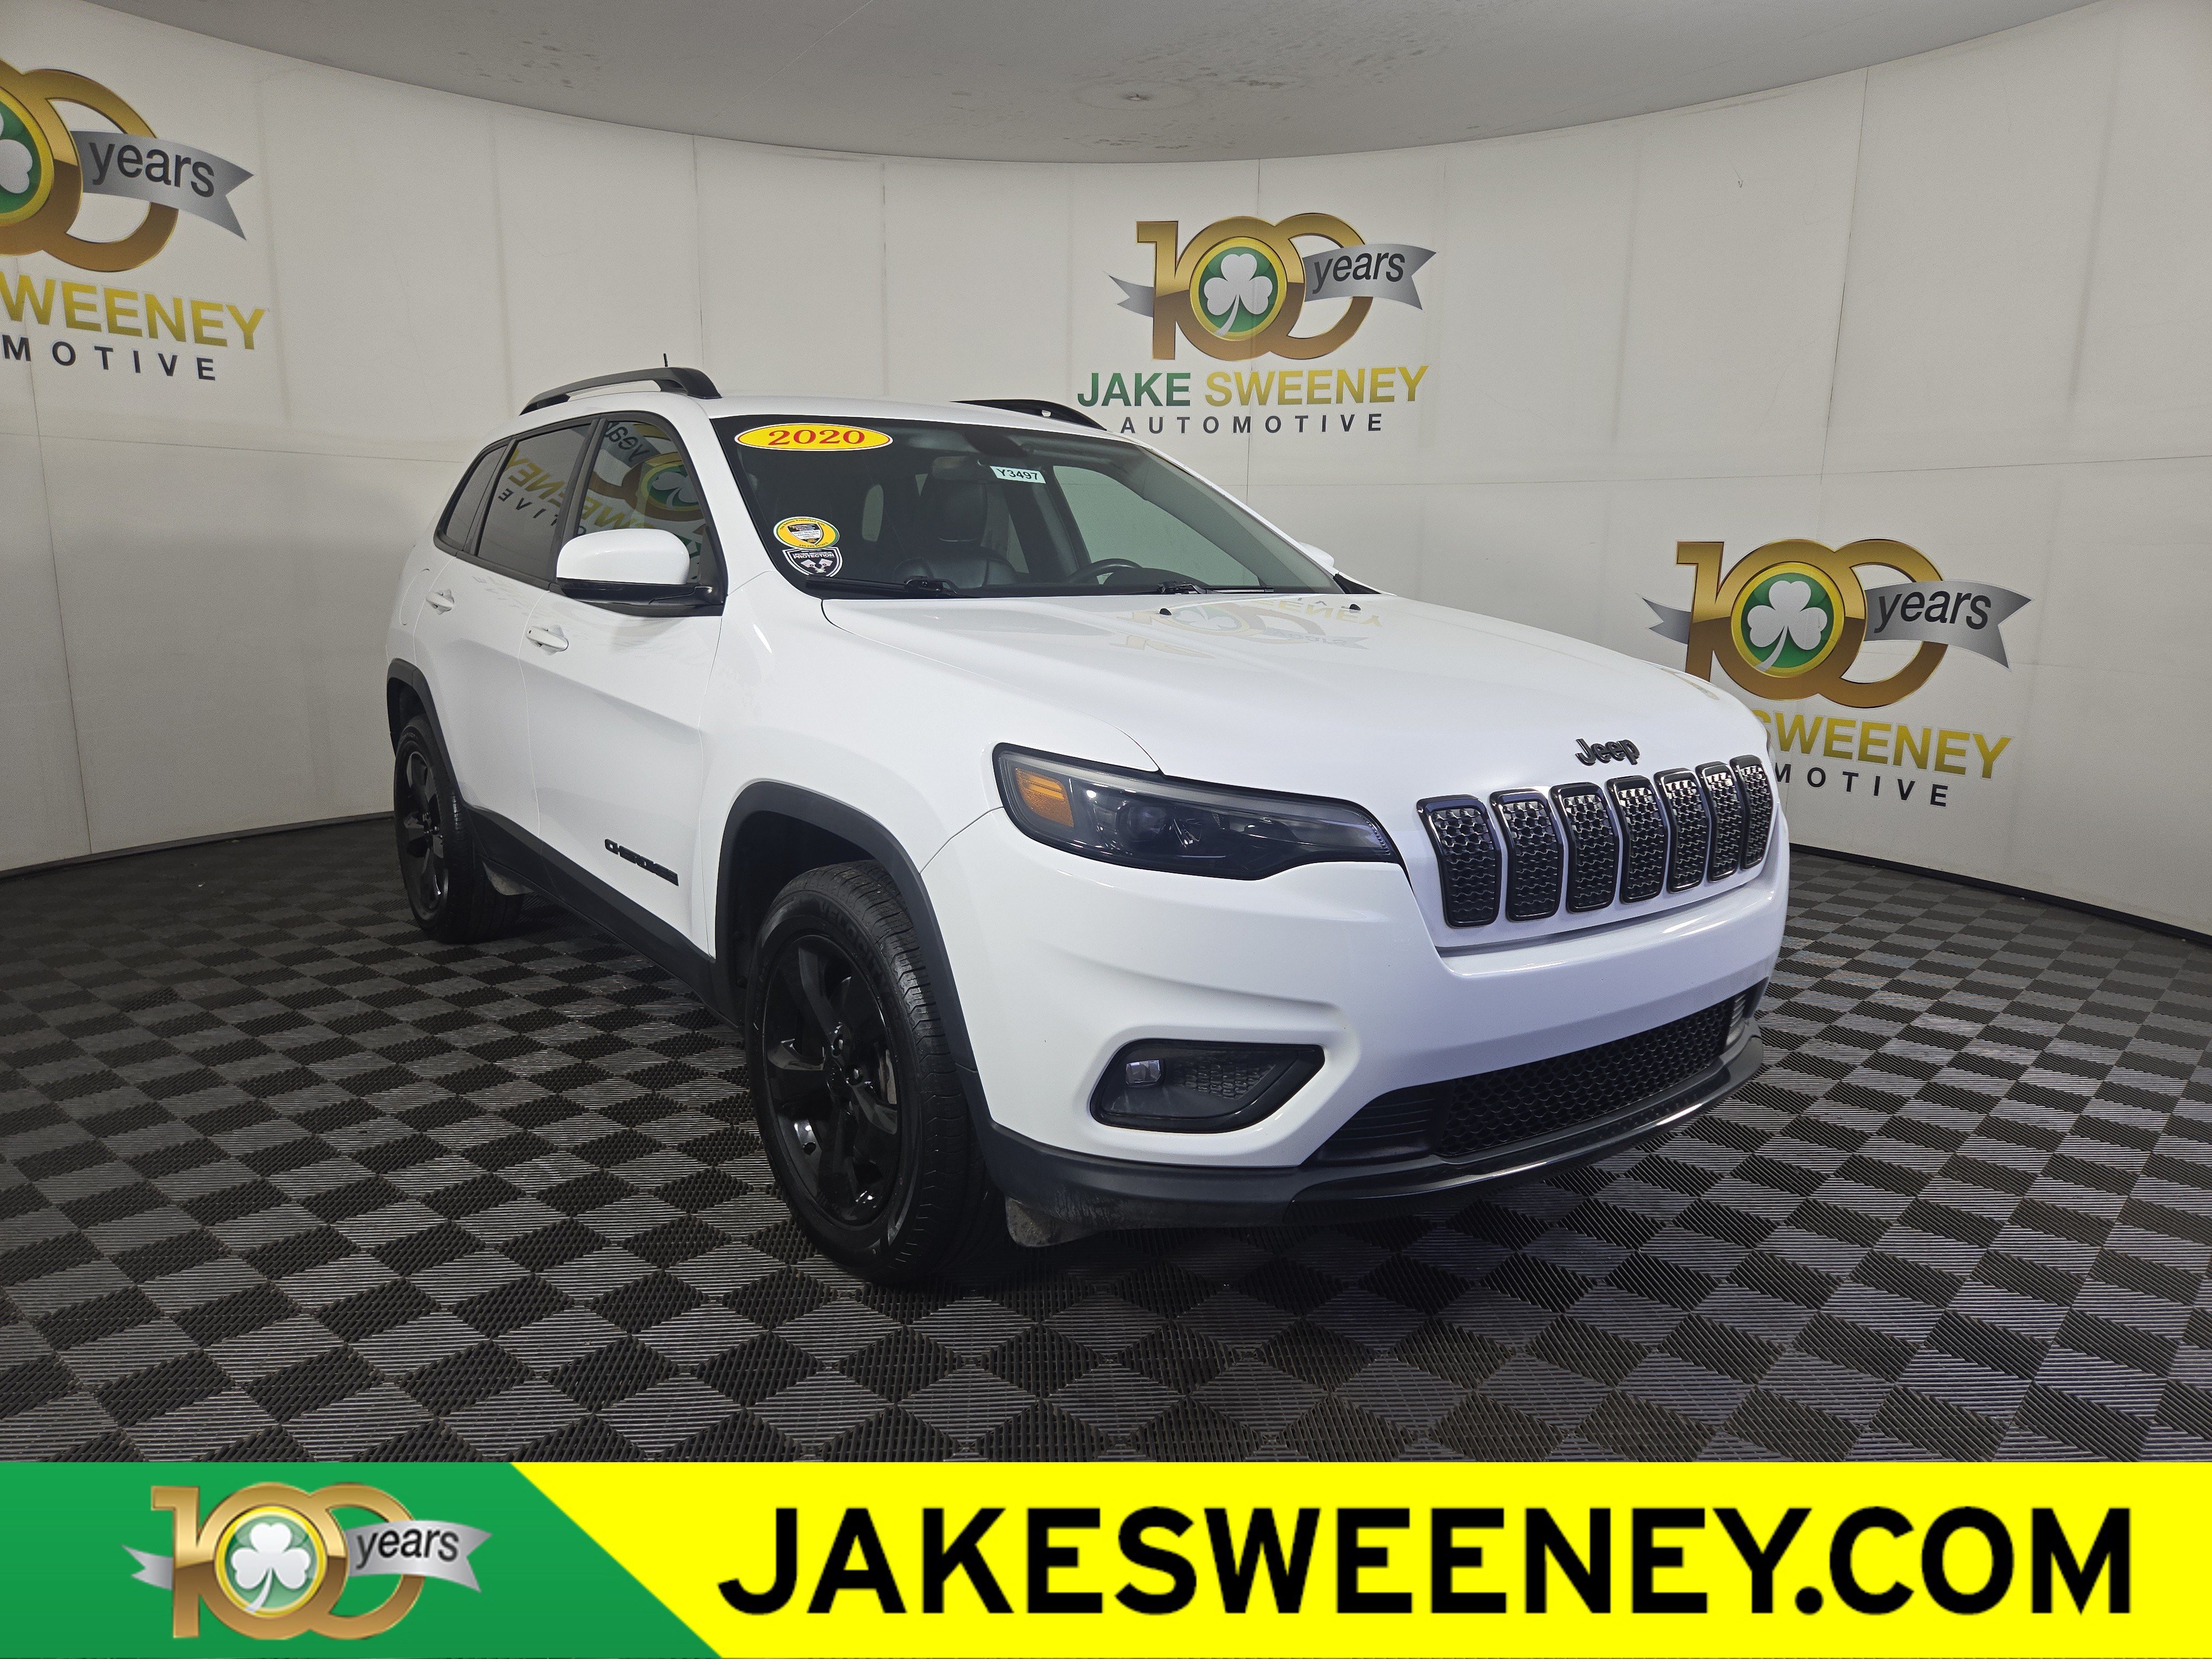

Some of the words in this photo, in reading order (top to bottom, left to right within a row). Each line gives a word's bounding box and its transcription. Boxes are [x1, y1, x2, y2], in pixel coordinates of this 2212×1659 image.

[89, 142, 215, 197] years
[1136, 212, 1374, 362] 100
[1312, 252, 1405, 294] years
[1077, 372, 1191, 407] JAKE
[1205, 365, 1429, 407] SWEENEY
[768, 429, 865, 446] 2020
[1120, 413, 1382, 434] AUTOMOTIVE
[996, 467, 1039, 481] Y3497
[1676, 538, 1949, 709] 100
[1873, 590, 1992, 634] years
[1575, 738, 1640, 766] Jeep
